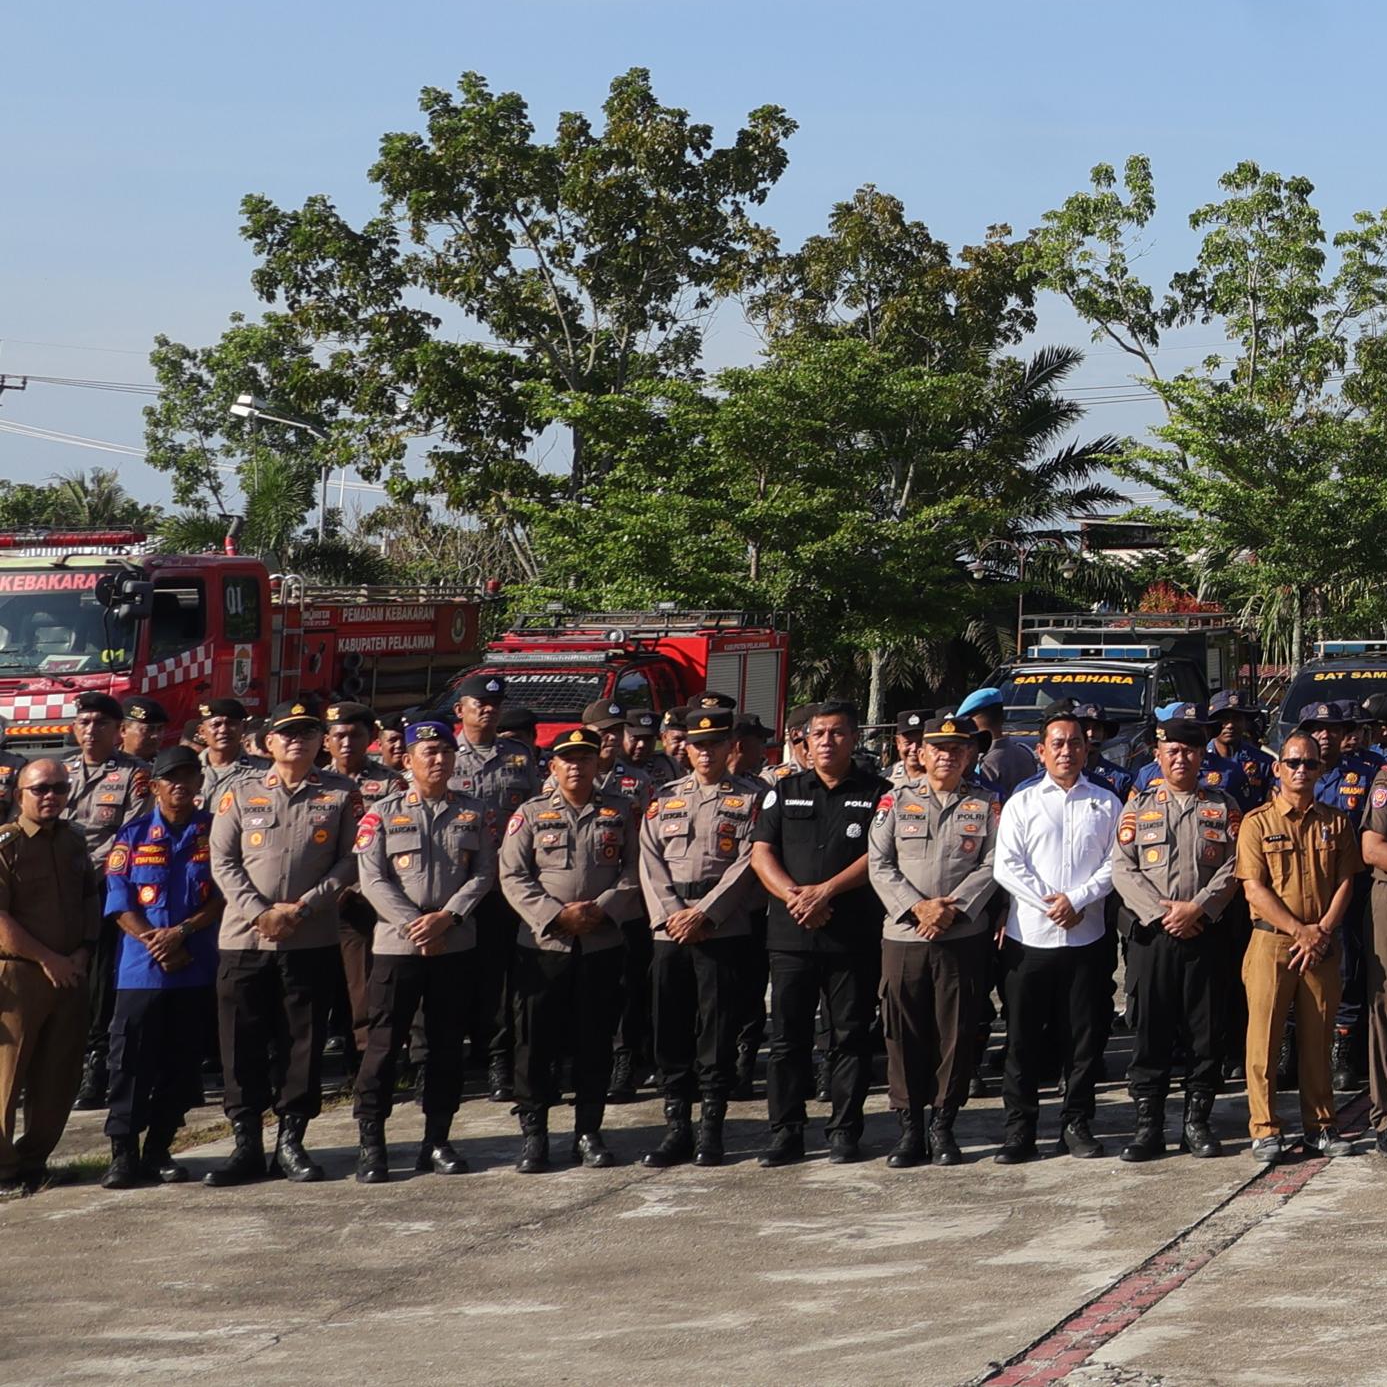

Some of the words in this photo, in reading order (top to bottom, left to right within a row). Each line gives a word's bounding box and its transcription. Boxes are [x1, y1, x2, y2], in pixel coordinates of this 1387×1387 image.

[342, 608, 384, 622] PEMADAM
[385, 606, 435, 621] KEBAKARAN
[338, 637, 387, 652] KABUPATEN
[388, 635, 435, 650] PELALAWAN
[504, 675, 600, 685] KARHUTLA
[1013, 675, 1048, 685] SAT
[1050, 674, 1134, 685] SABHARA
[1313, 672, 1347, 681] SAT
[308, 804, 339, 813] POLRI
[844, 800, 872, 808] POLRI
[957, 813, 985, 821] POLRI
